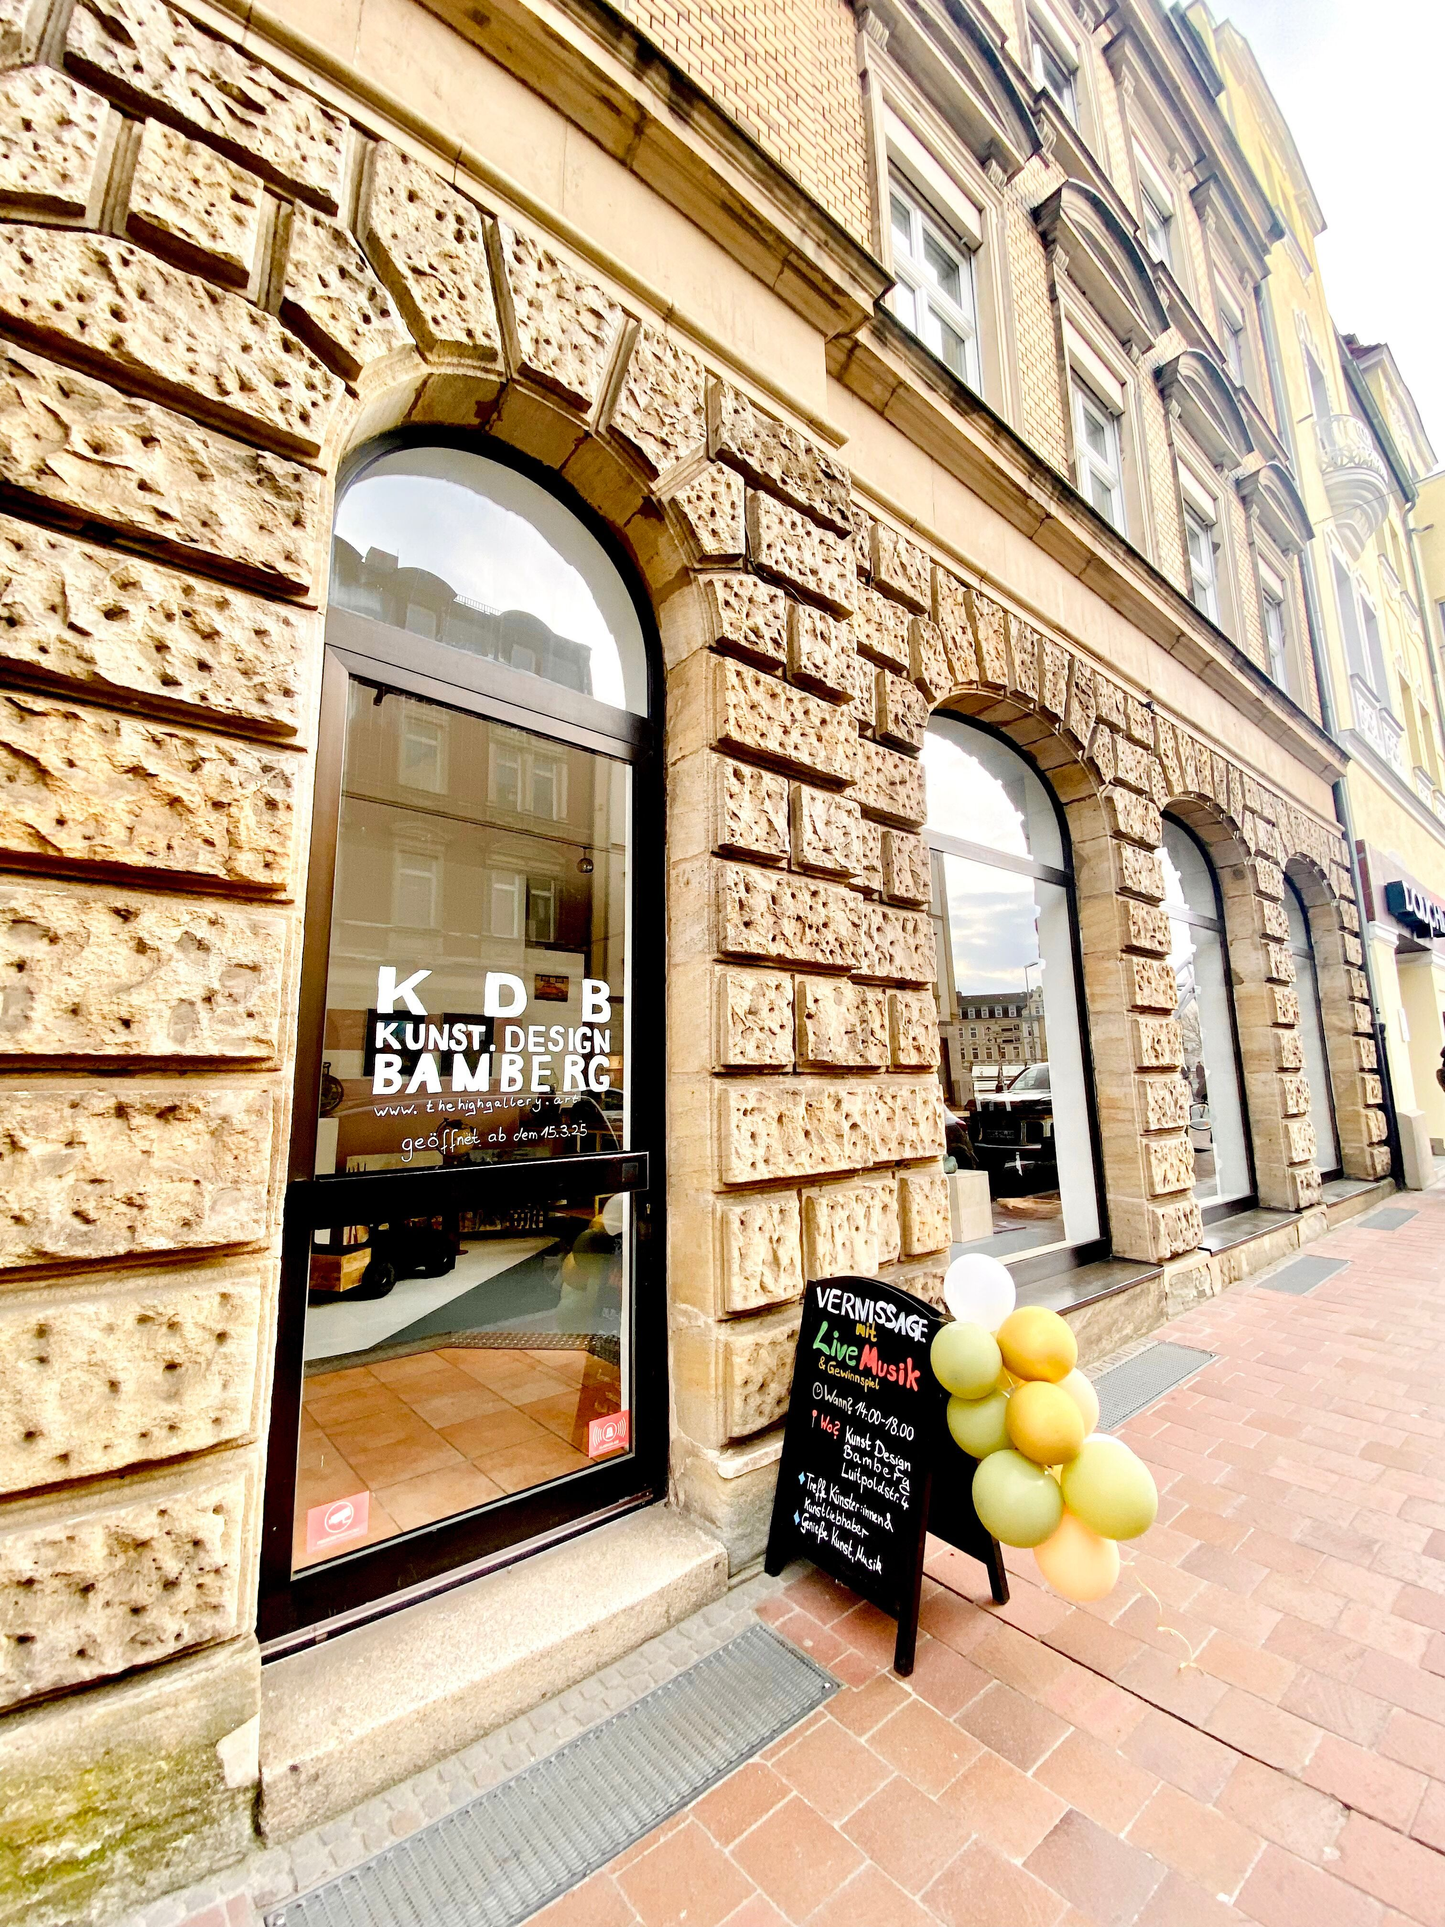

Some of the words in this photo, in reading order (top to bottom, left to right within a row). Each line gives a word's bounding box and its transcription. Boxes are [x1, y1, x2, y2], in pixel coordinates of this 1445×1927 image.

[504, 1025, 611, 1054] DESIGN
[372, 1052, 611, 1095] BAMBERG
[401, 1128, 481, 1162] geöffnet
[487, 1127, 507, 1142] ab
[513, 1128, 538, 1141] dem
[540, 1123, 588, 1138] 15.3.25
[816, 1286, 928, 1343] VERNISSAGE
[855, 1321, 878, 1342] mit
[812, 1320, 859, 1367] Live
[858, 1343, 921, 1392] Musik
[818, 1356, 826, 1370] &
[827, 1360, 880, 1393] Gewinnspiel
[820, 1413, 841, 1440] Wo?
[824, 1384, 853, 1415] Wann?
[854, 1401, 915, 1441] 14.00-18.00
[843, 1444, 910, 1496] Bamberg
[845, 1425, 872, 1451] Kunst
[874, 1439, 911, 1472] Design
[841, 1462, 900, 1503] Luitpoldstr.
[900, 1495, 910, 1511] 4
[804, 1496, 870, 1539] Kunstliebhaber
[800, 1512, 829, 1544] Genieße
[831, 1526, 854, 1563] Kunst,
[854, 1543, 882, 1575] Musik
